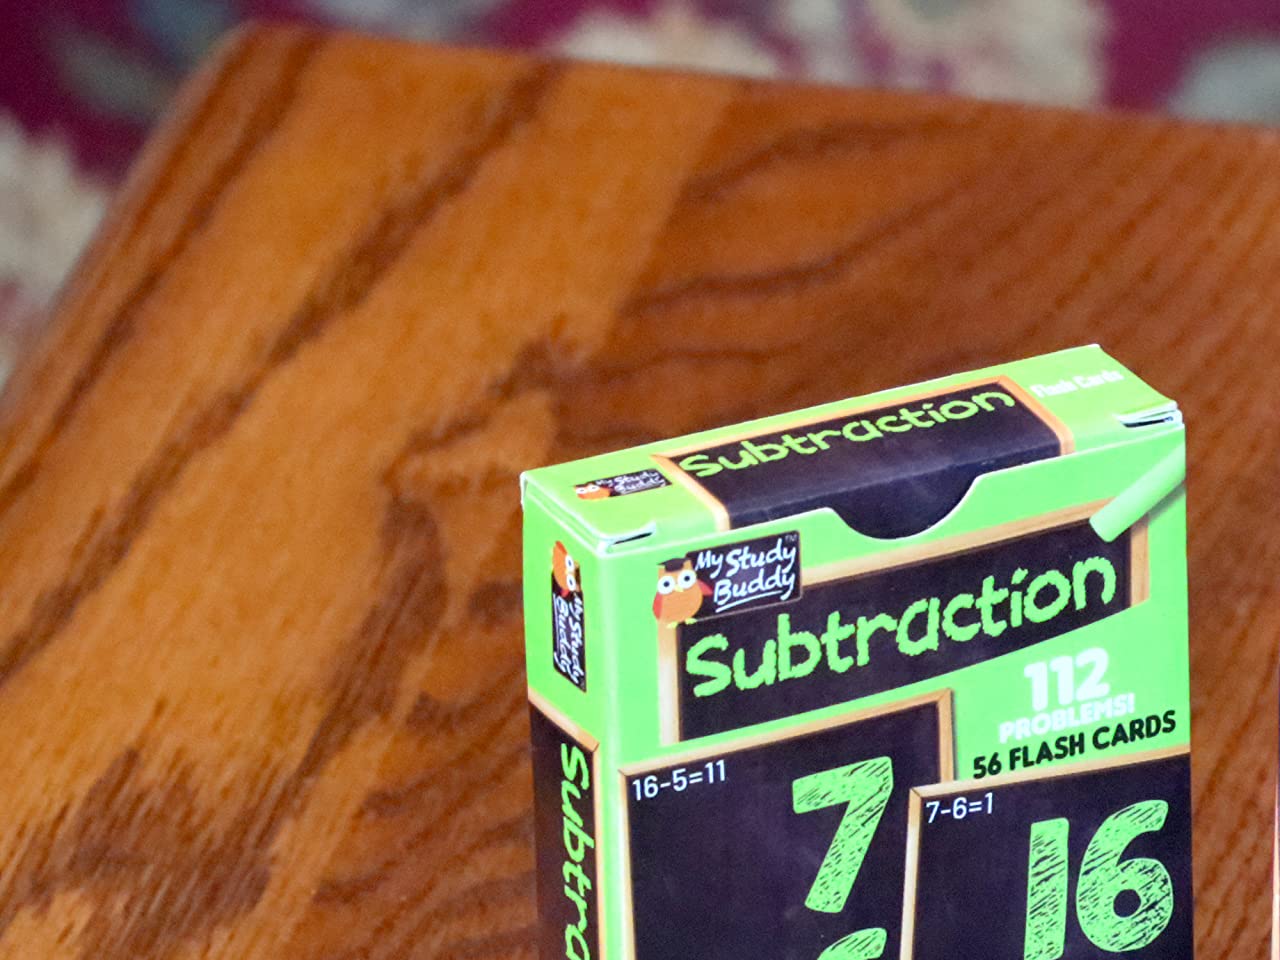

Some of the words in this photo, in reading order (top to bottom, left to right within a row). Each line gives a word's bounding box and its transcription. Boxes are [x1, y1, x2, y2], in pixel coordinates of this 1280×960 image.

[678, 391, 1016, 477] Subtraction
[695, 550, 723, 579] My
[725, 538, 797, 577] Study
[713, 564, 796, 608] Buddy
[553, 595, 571, 673] Buddy
[567, 616, 584, 684] Study
[685, 556, 1117, 698] Subtraction
[1023, 646, 1110, 712] 112
[972, 752, 1002, 780] 56
[1009, 731, 1085, 771] FLASH
[1092, 709, 1177, 750] CARDS
[998, 691, 1136, 744] PROBLEMS!
[630, 758, 728, 802] 16-5=11
[925, 790, 996, 825] 7-6=1
[791, 755, 894, 914] 7
